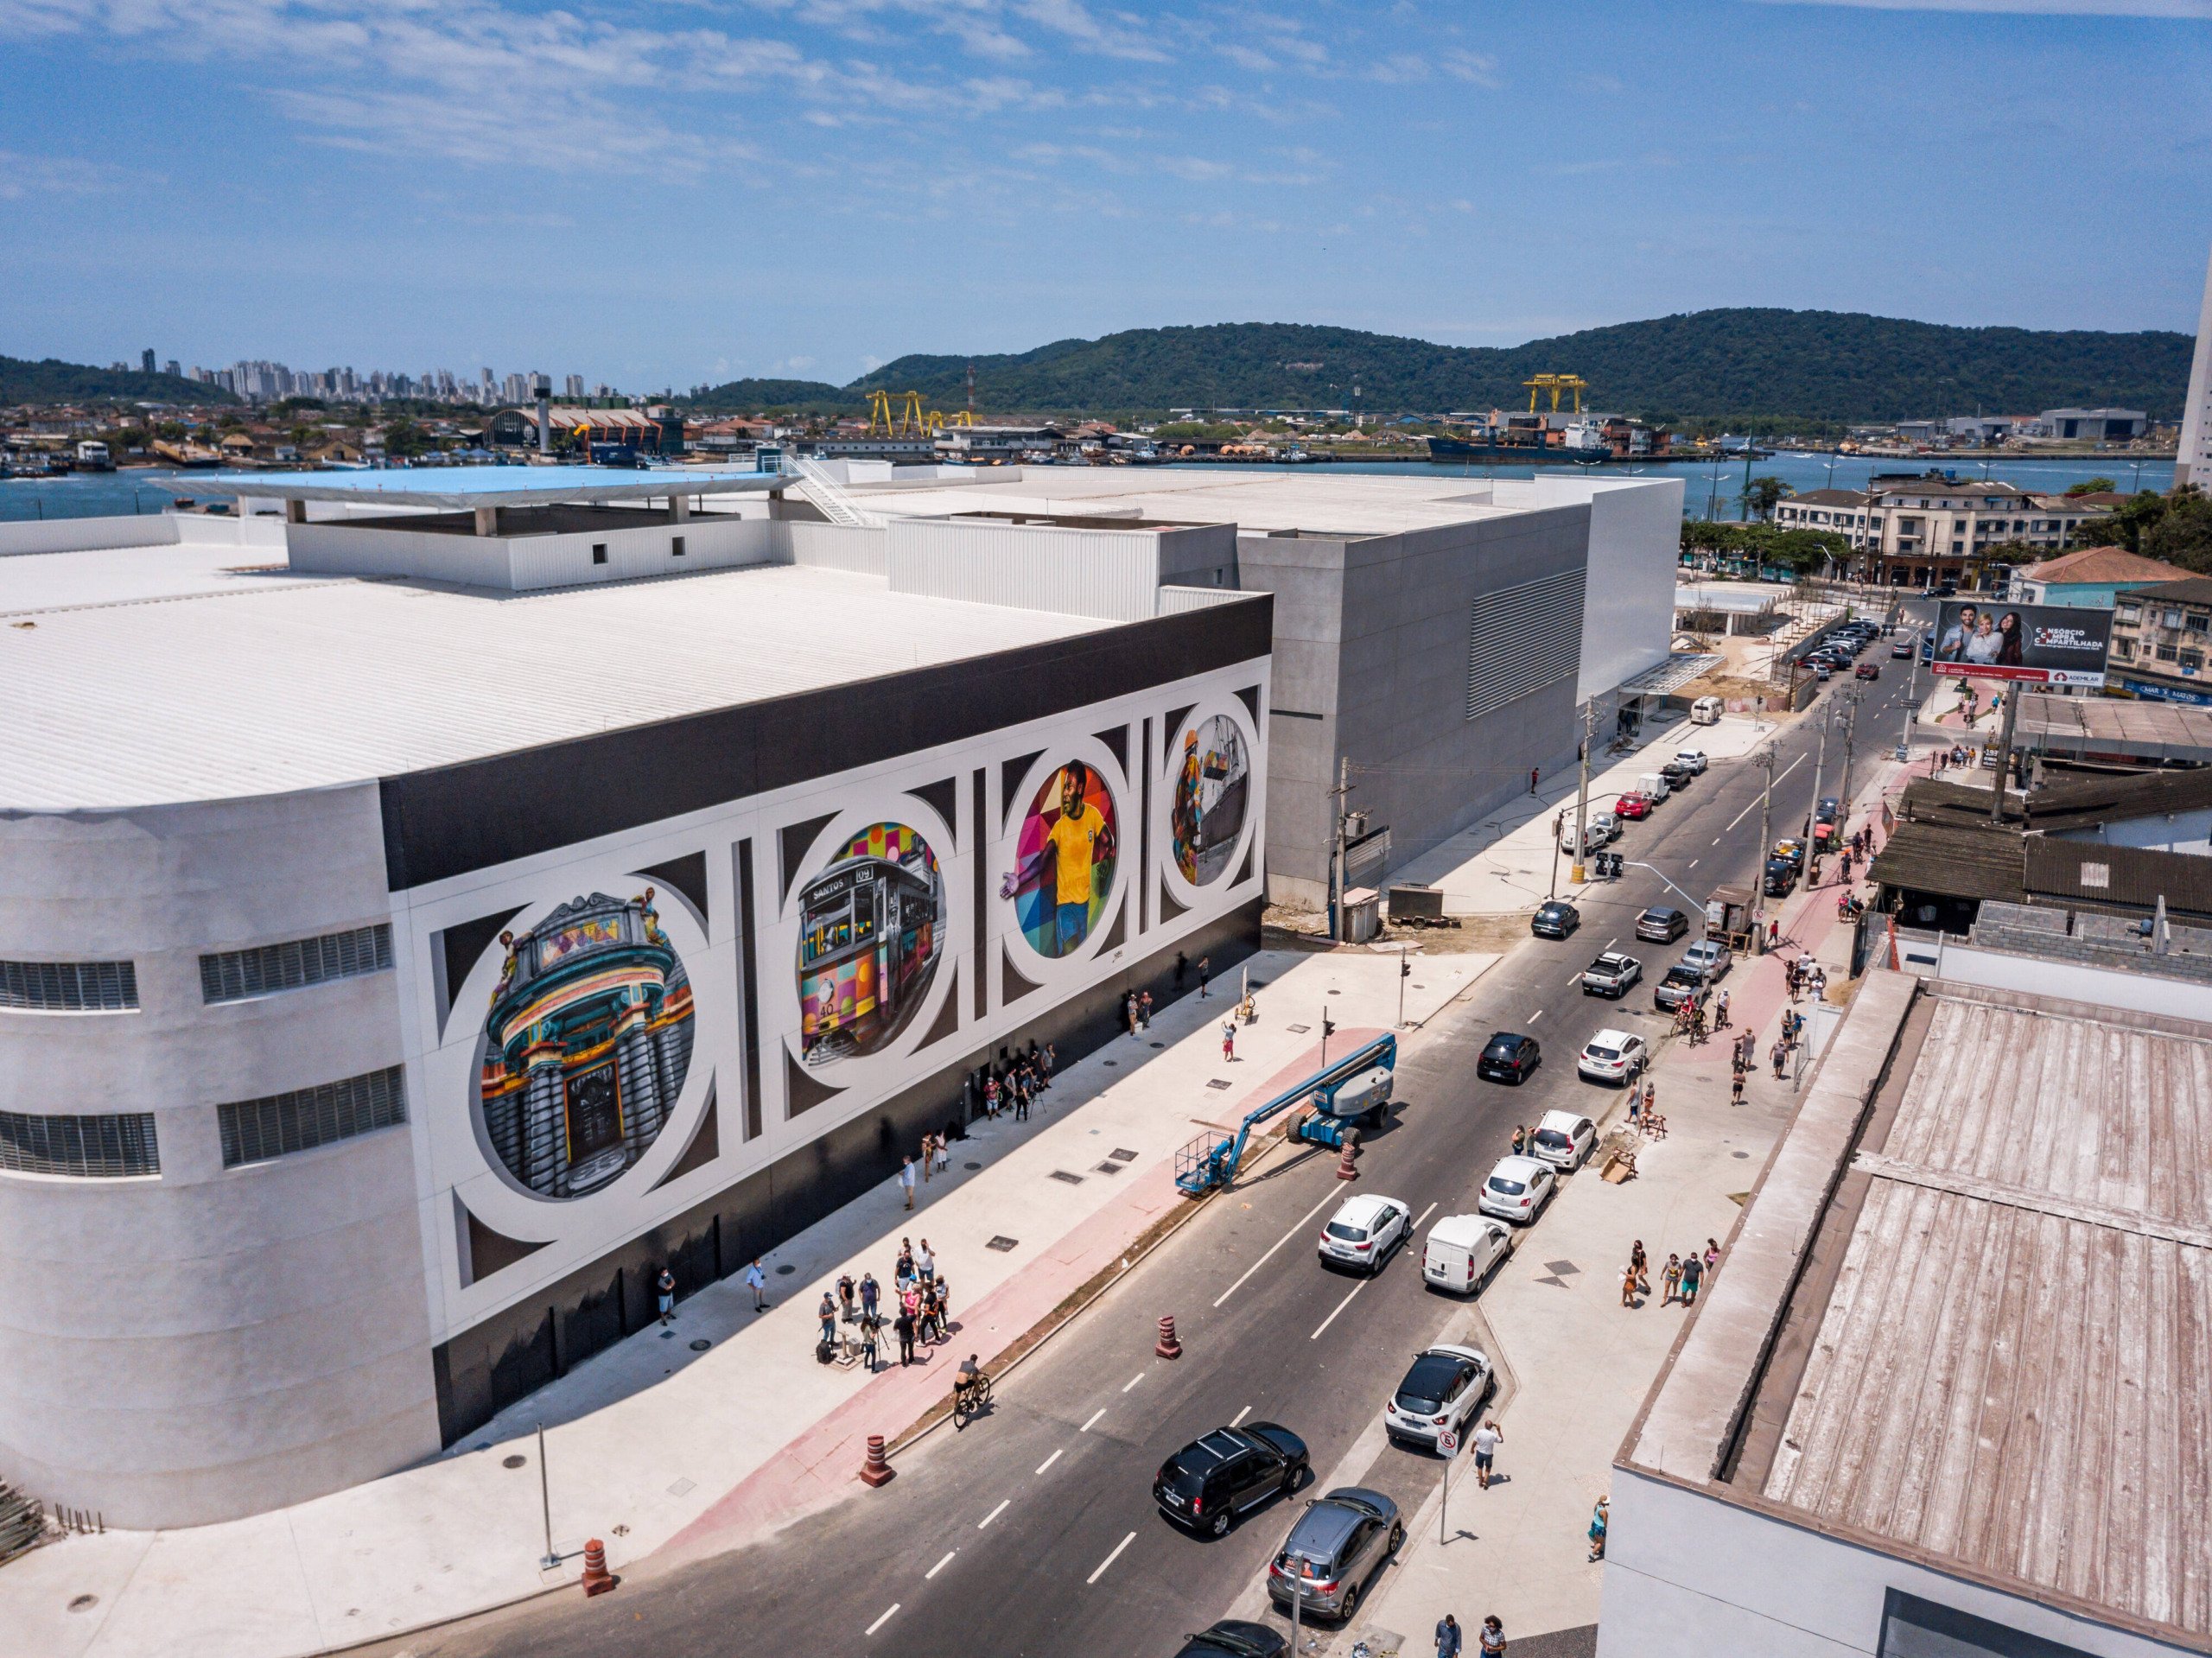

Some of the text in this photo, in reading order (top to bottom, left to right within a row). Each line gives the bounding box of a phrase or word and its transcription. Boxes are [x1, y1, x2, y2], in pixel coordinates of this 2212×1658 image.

[2034, 638, 2103, 648] COMPARTILHADA
[858, 868, 870, 880] 09
[813, 879, 844, 900] SANTOS
[820, 1003, 834, 1018] 40
